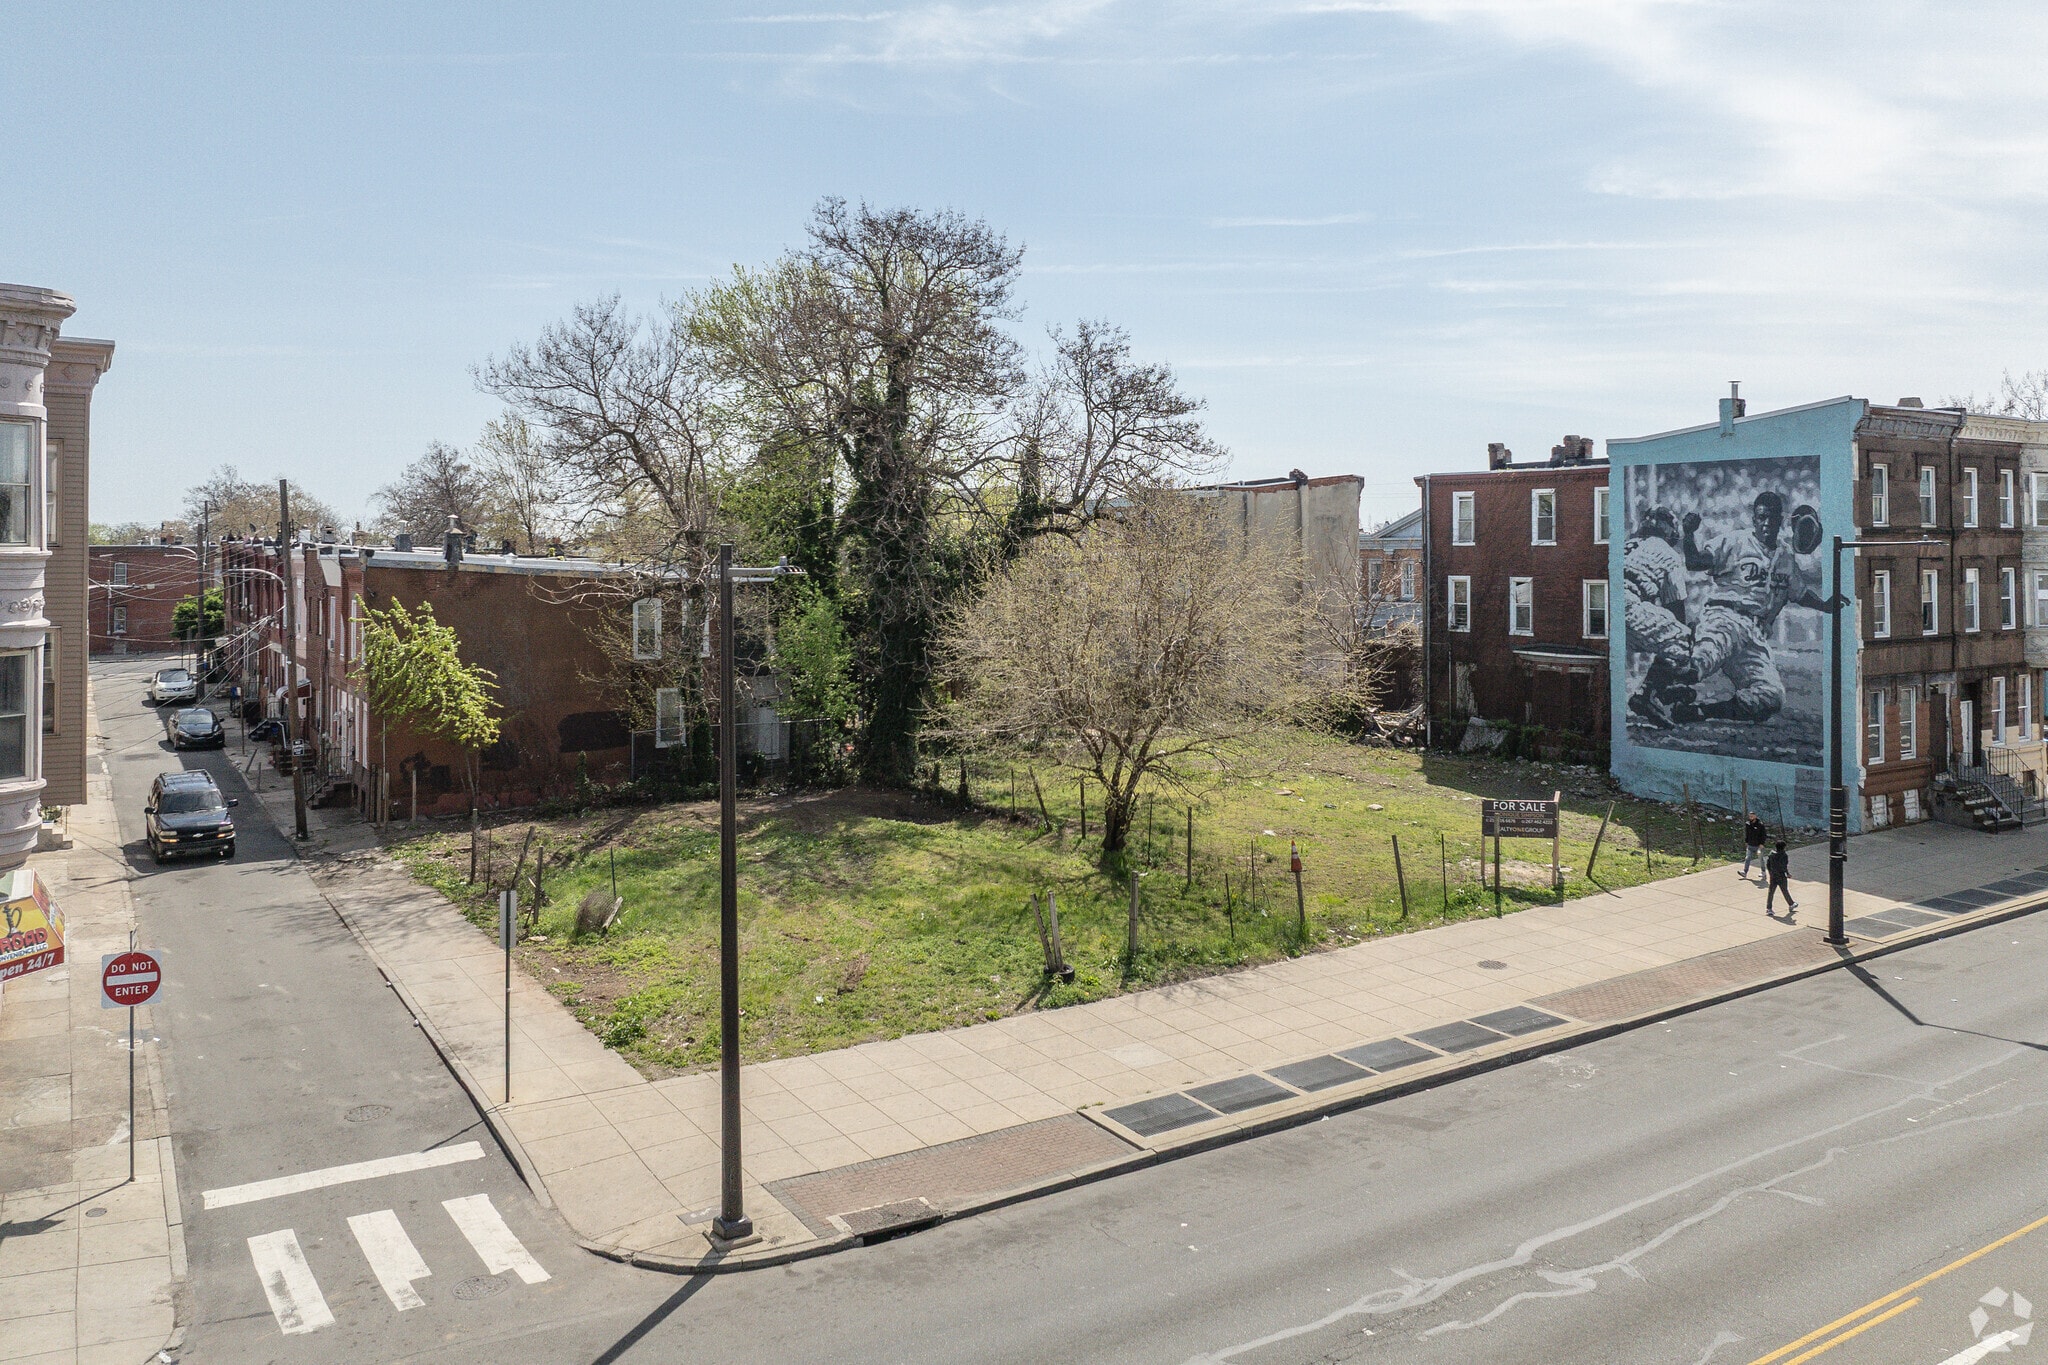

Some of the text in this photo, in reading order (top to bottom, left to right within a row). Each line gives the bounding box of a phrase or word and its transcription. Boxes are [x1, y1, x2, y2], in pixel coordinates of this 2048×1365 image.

[1493, 801, 1546, 812] FOR SALE
[27, 952, 55, 970] 24/7
[111, 961, 153, 974] DO NOT
[115, 984, 149, 997] ENTER
